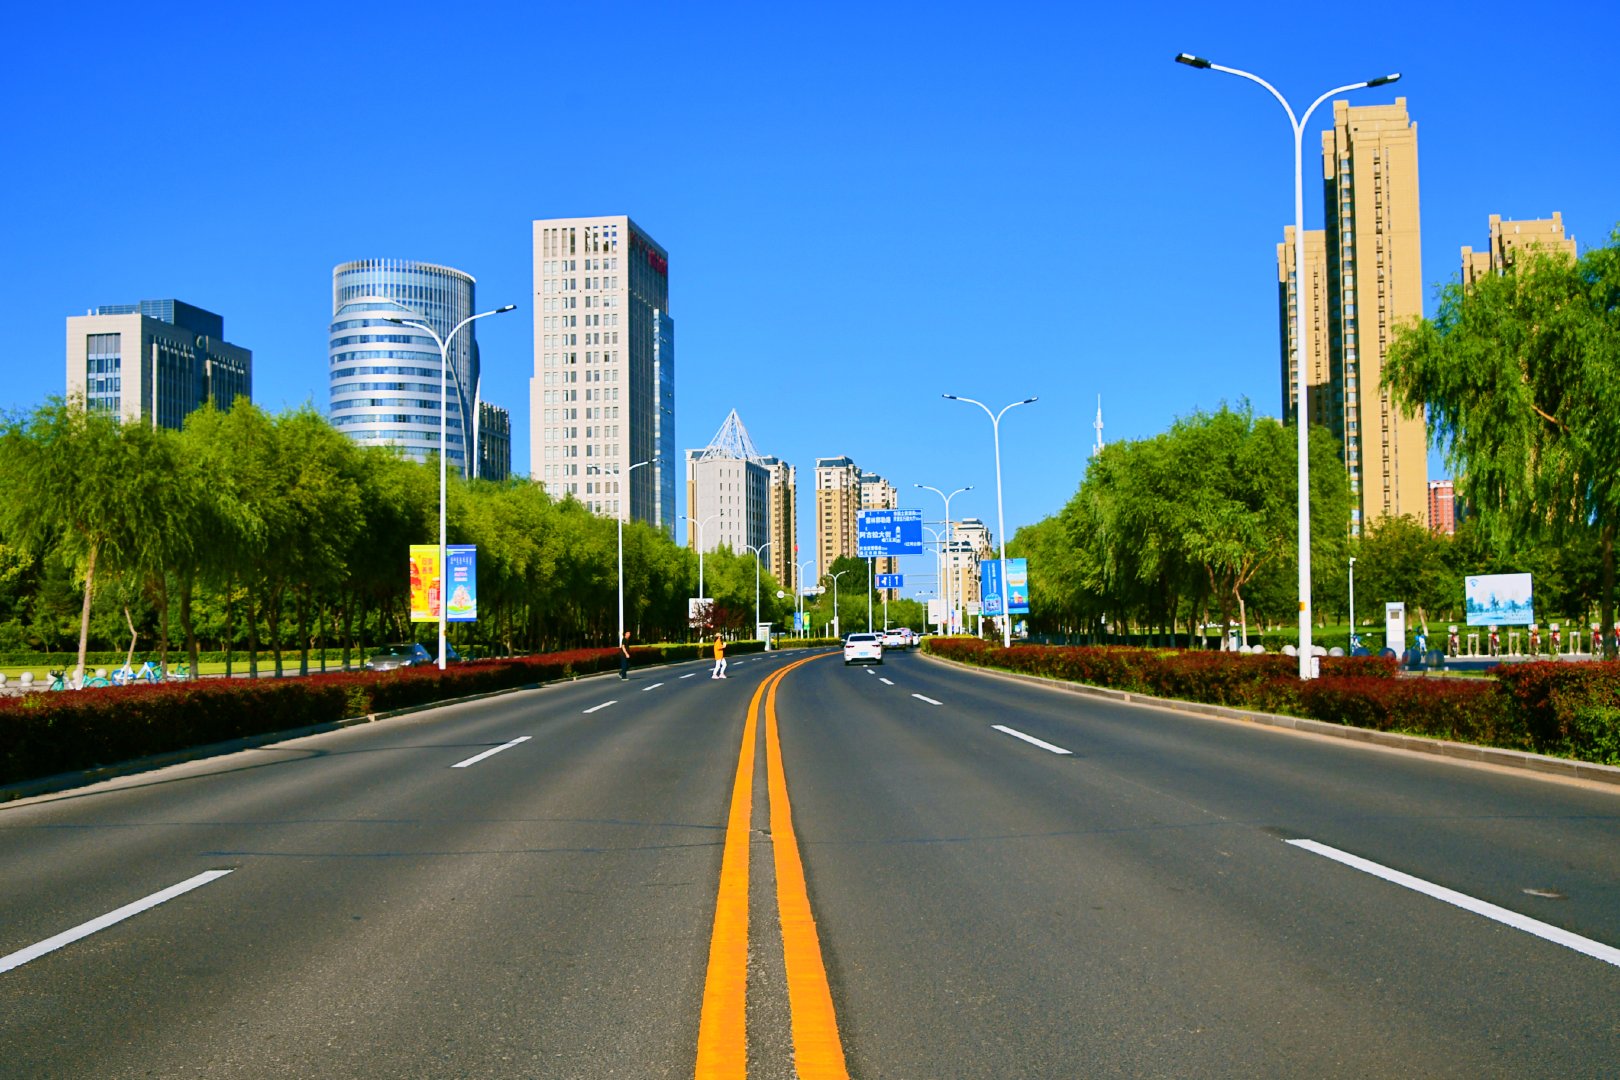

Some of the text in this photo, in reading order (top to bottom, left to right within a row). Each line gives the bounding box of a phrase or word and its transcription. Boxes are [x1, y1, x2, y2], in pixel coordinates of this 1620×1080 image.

[859, 531, 892, 539] 阿古拉大街
